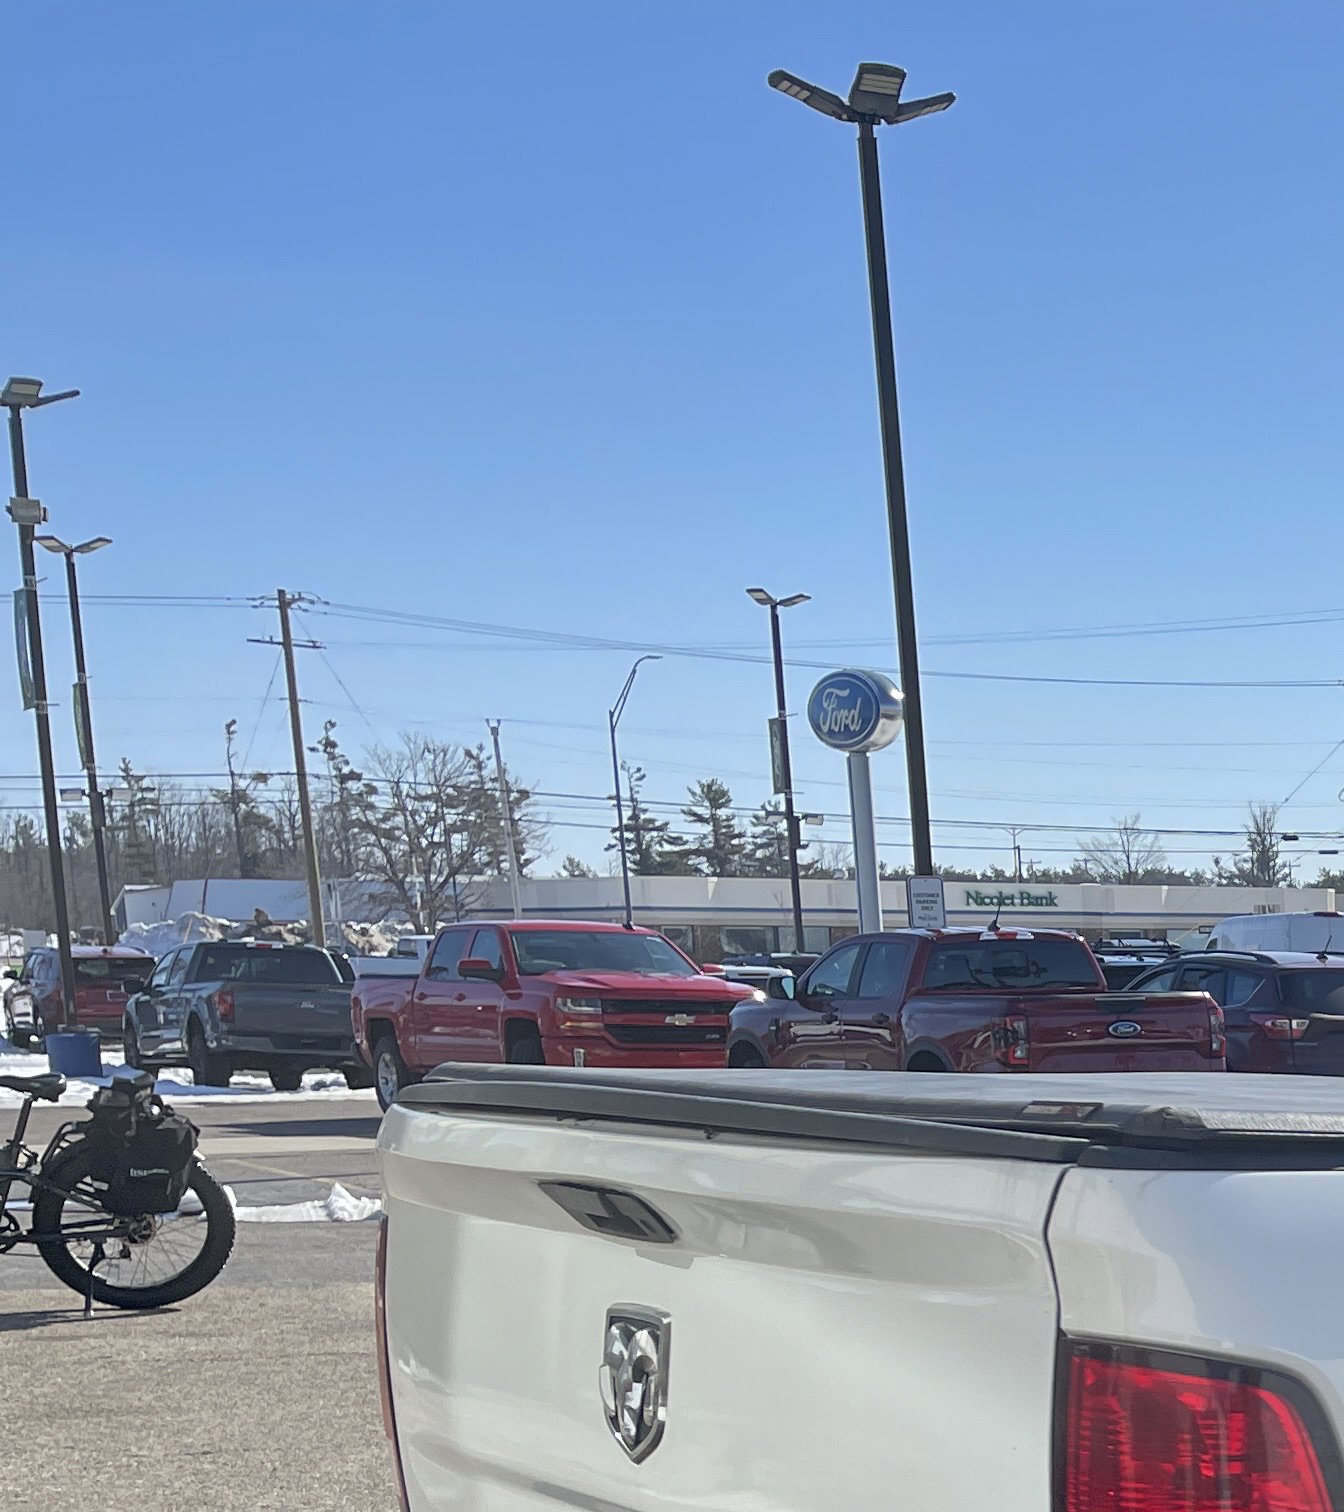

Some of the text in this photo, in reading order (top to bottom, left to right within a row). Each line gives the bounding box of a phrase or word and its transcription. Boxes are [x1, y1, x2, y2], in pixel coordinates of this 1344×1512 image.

[819, 687, 862, 733] Ford
[964, 889, 1059, 907] Nicolet Bank
